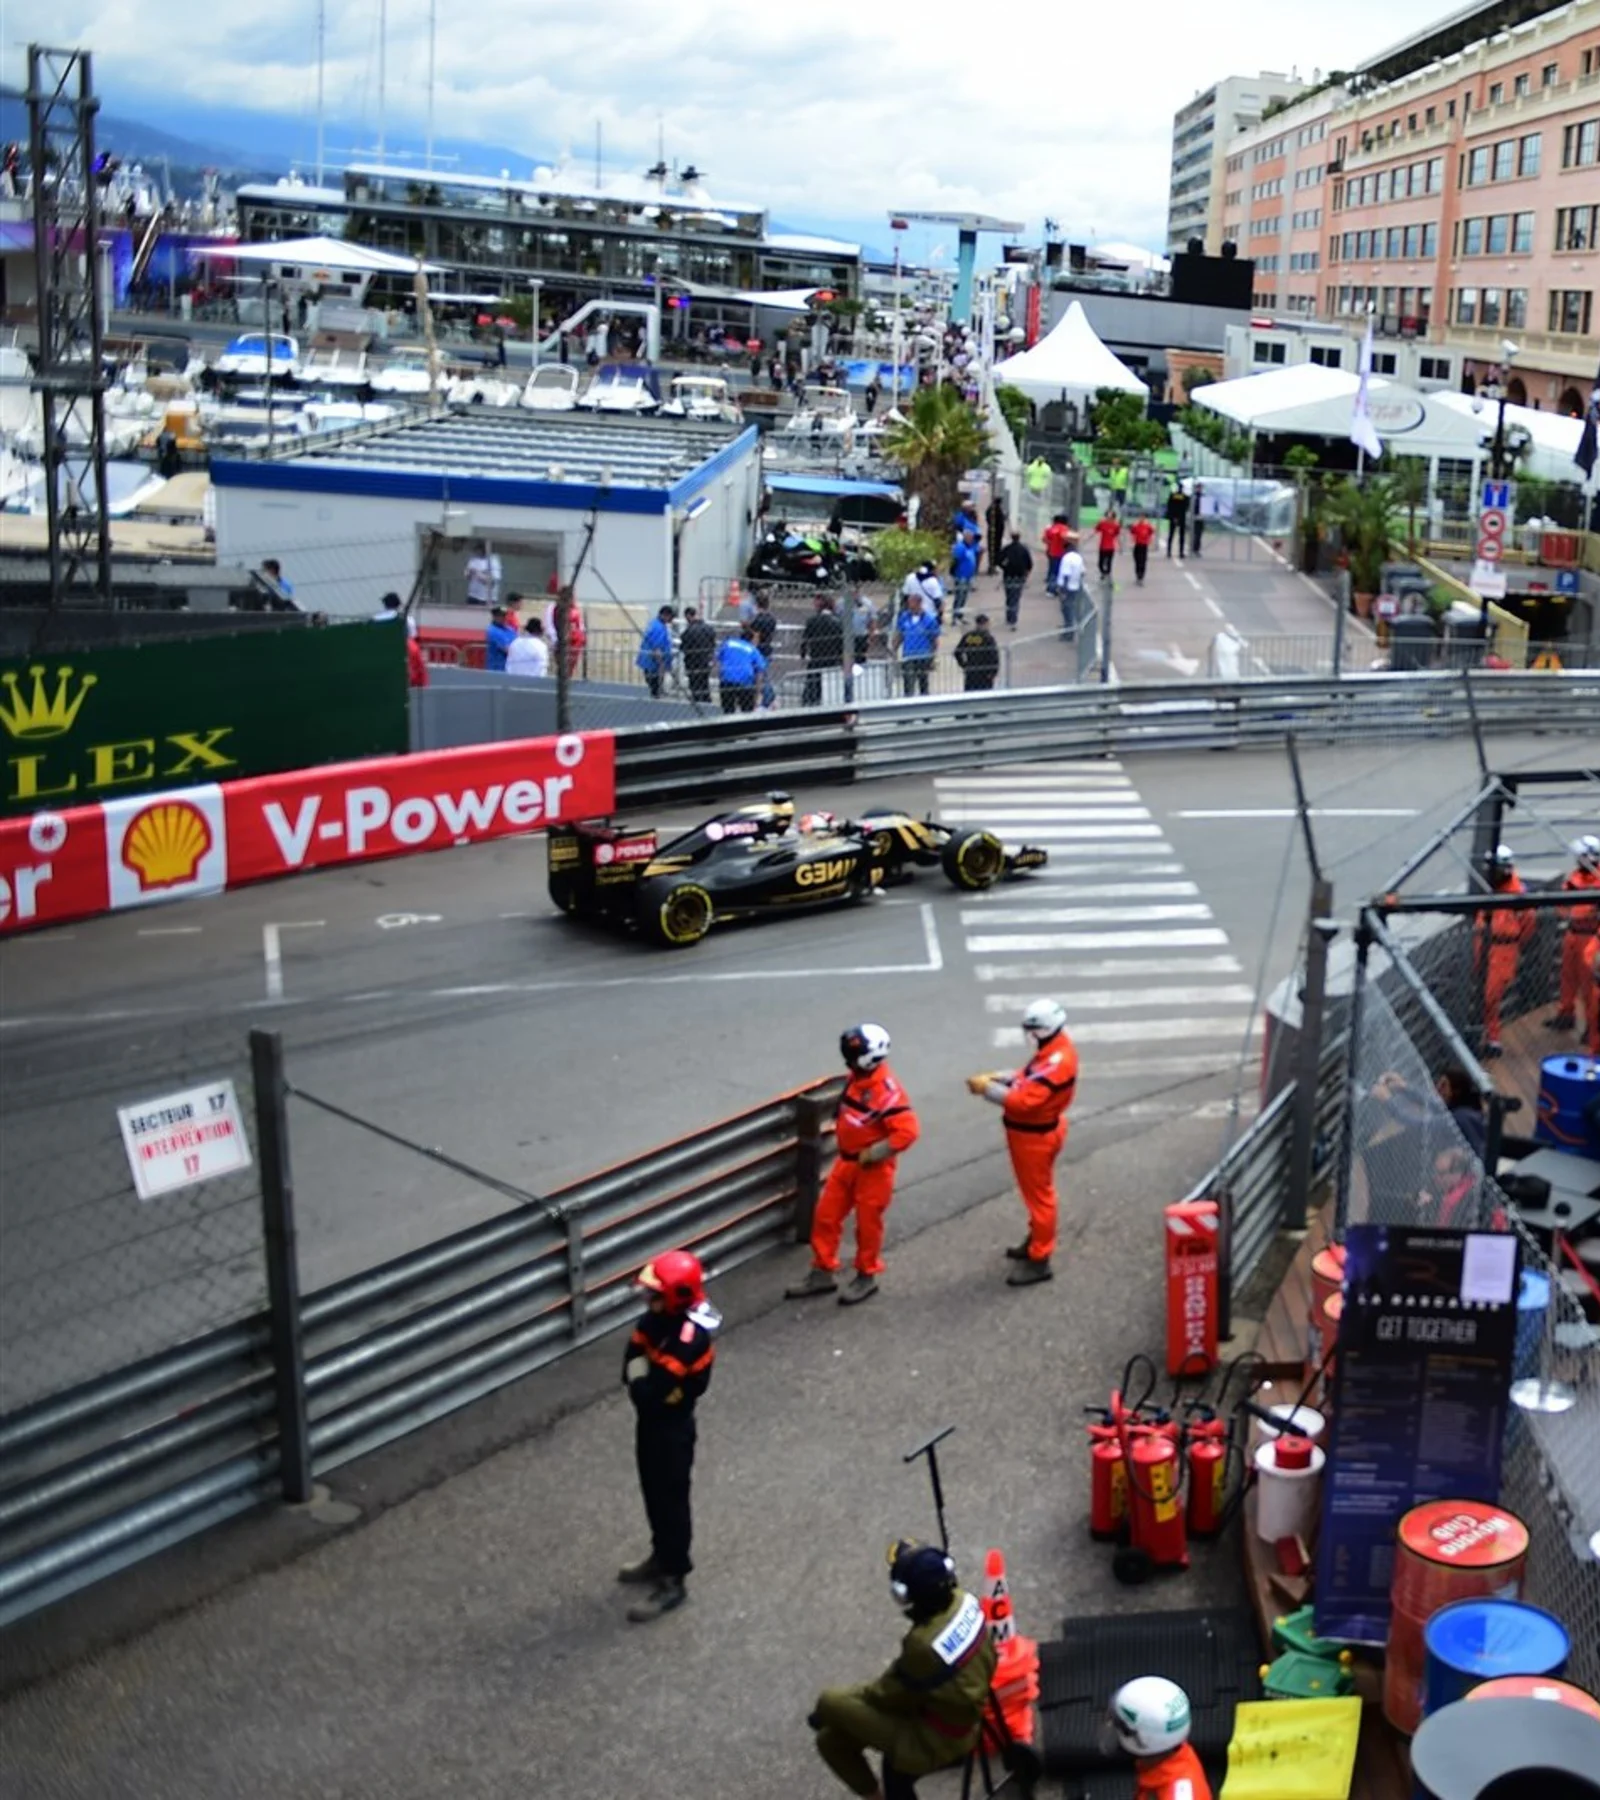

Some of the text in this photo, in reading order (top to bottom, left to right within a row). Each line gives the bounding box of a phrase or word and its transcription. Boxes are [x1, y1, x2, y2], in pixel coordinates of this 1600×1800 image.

[262, 772, 574, 867] V-Power
[130, 1092, 227, 1134] SECTEUR 17
[140, 1119, 234, 1159] INTERVENTION
[184, 1154, 200, 1176] 17
[1376, 1315, 1477, 1344] GET TOGETHER
